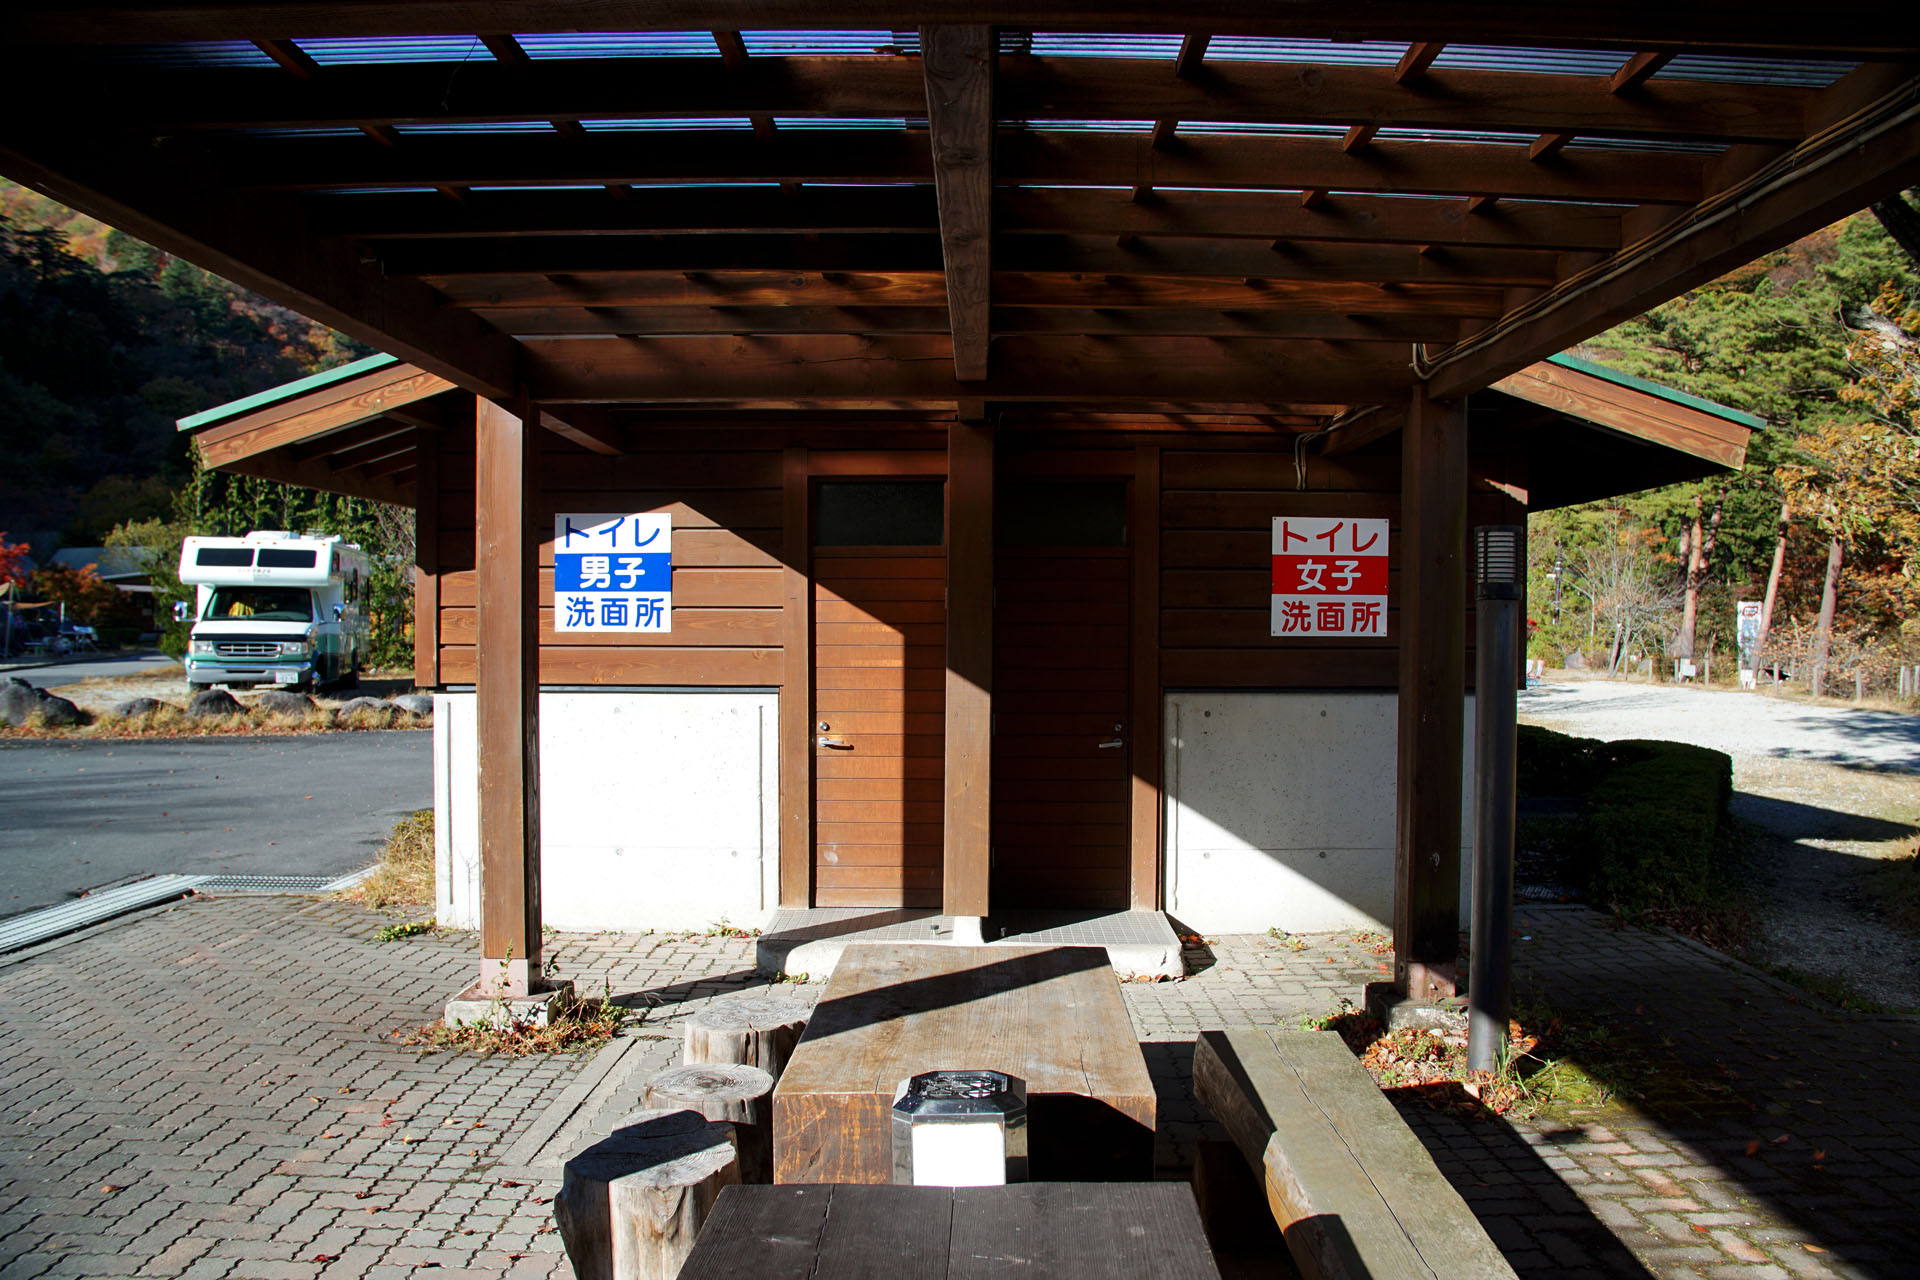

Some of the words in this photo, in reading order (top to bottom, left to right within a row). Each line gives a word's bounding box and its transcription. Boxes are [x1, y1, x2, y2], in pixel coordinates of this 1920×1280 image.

[566, 517, 660, 548] トイレ
[1282, 520, 1378, 553] トイレ
[579, 556, 646, 590] 男子
[1296, 558, 1362, 592] 女子
[566, 596, 665, 628] 洗面所
[1281, 600, 1381, 633] 洗面所
